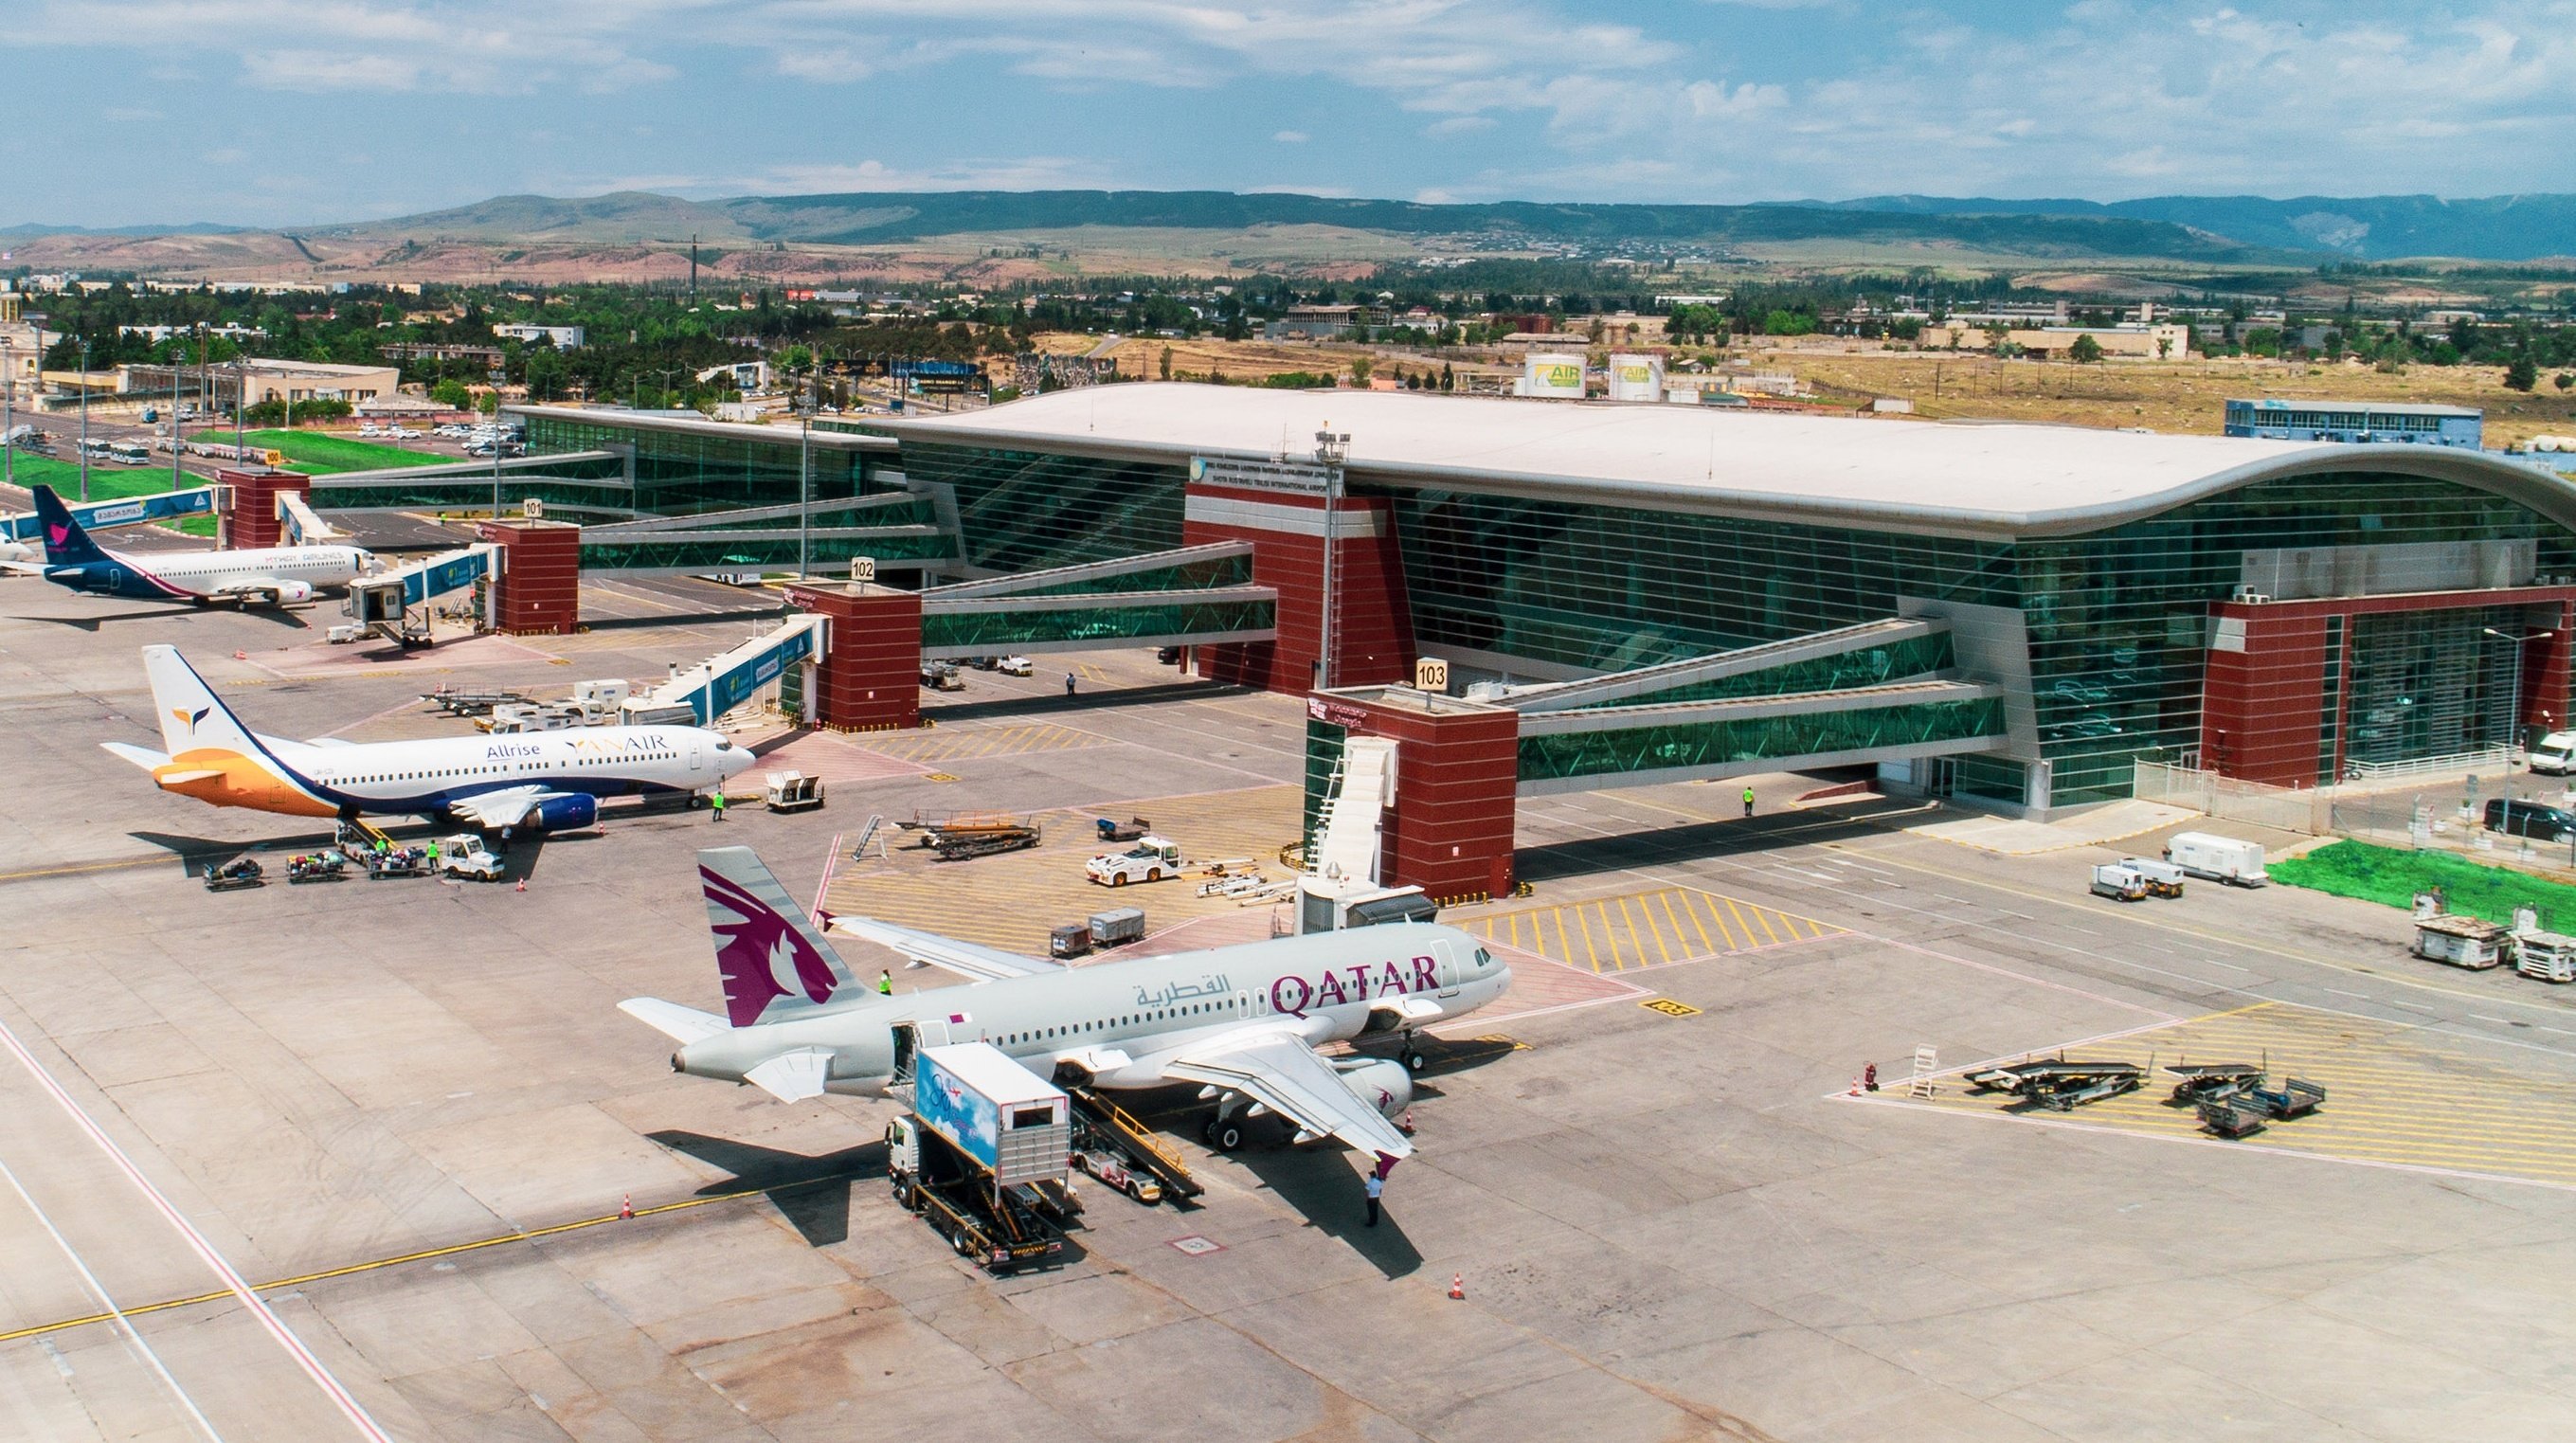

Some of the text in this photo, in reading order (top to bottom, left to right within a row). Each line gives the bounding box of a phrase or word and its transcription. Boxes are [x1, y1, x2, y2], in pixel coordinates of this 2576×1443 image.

[1551, 366, 1580, 379] AIR
[1626, 367, 1648, 378] AIR
[267, 452, 279, 462] 100
[526, 501, 543, 514] 101
[853, 562, 874, 577] 102
[1419, 666, 1446, 685] 103
[487, 744, 541, 759] Allrise
[565, 734, 671, 755] YANAIR
[1133, 974, 1232, 1007] القطرية
[1270, 955, 1441, 1020] QATAR
